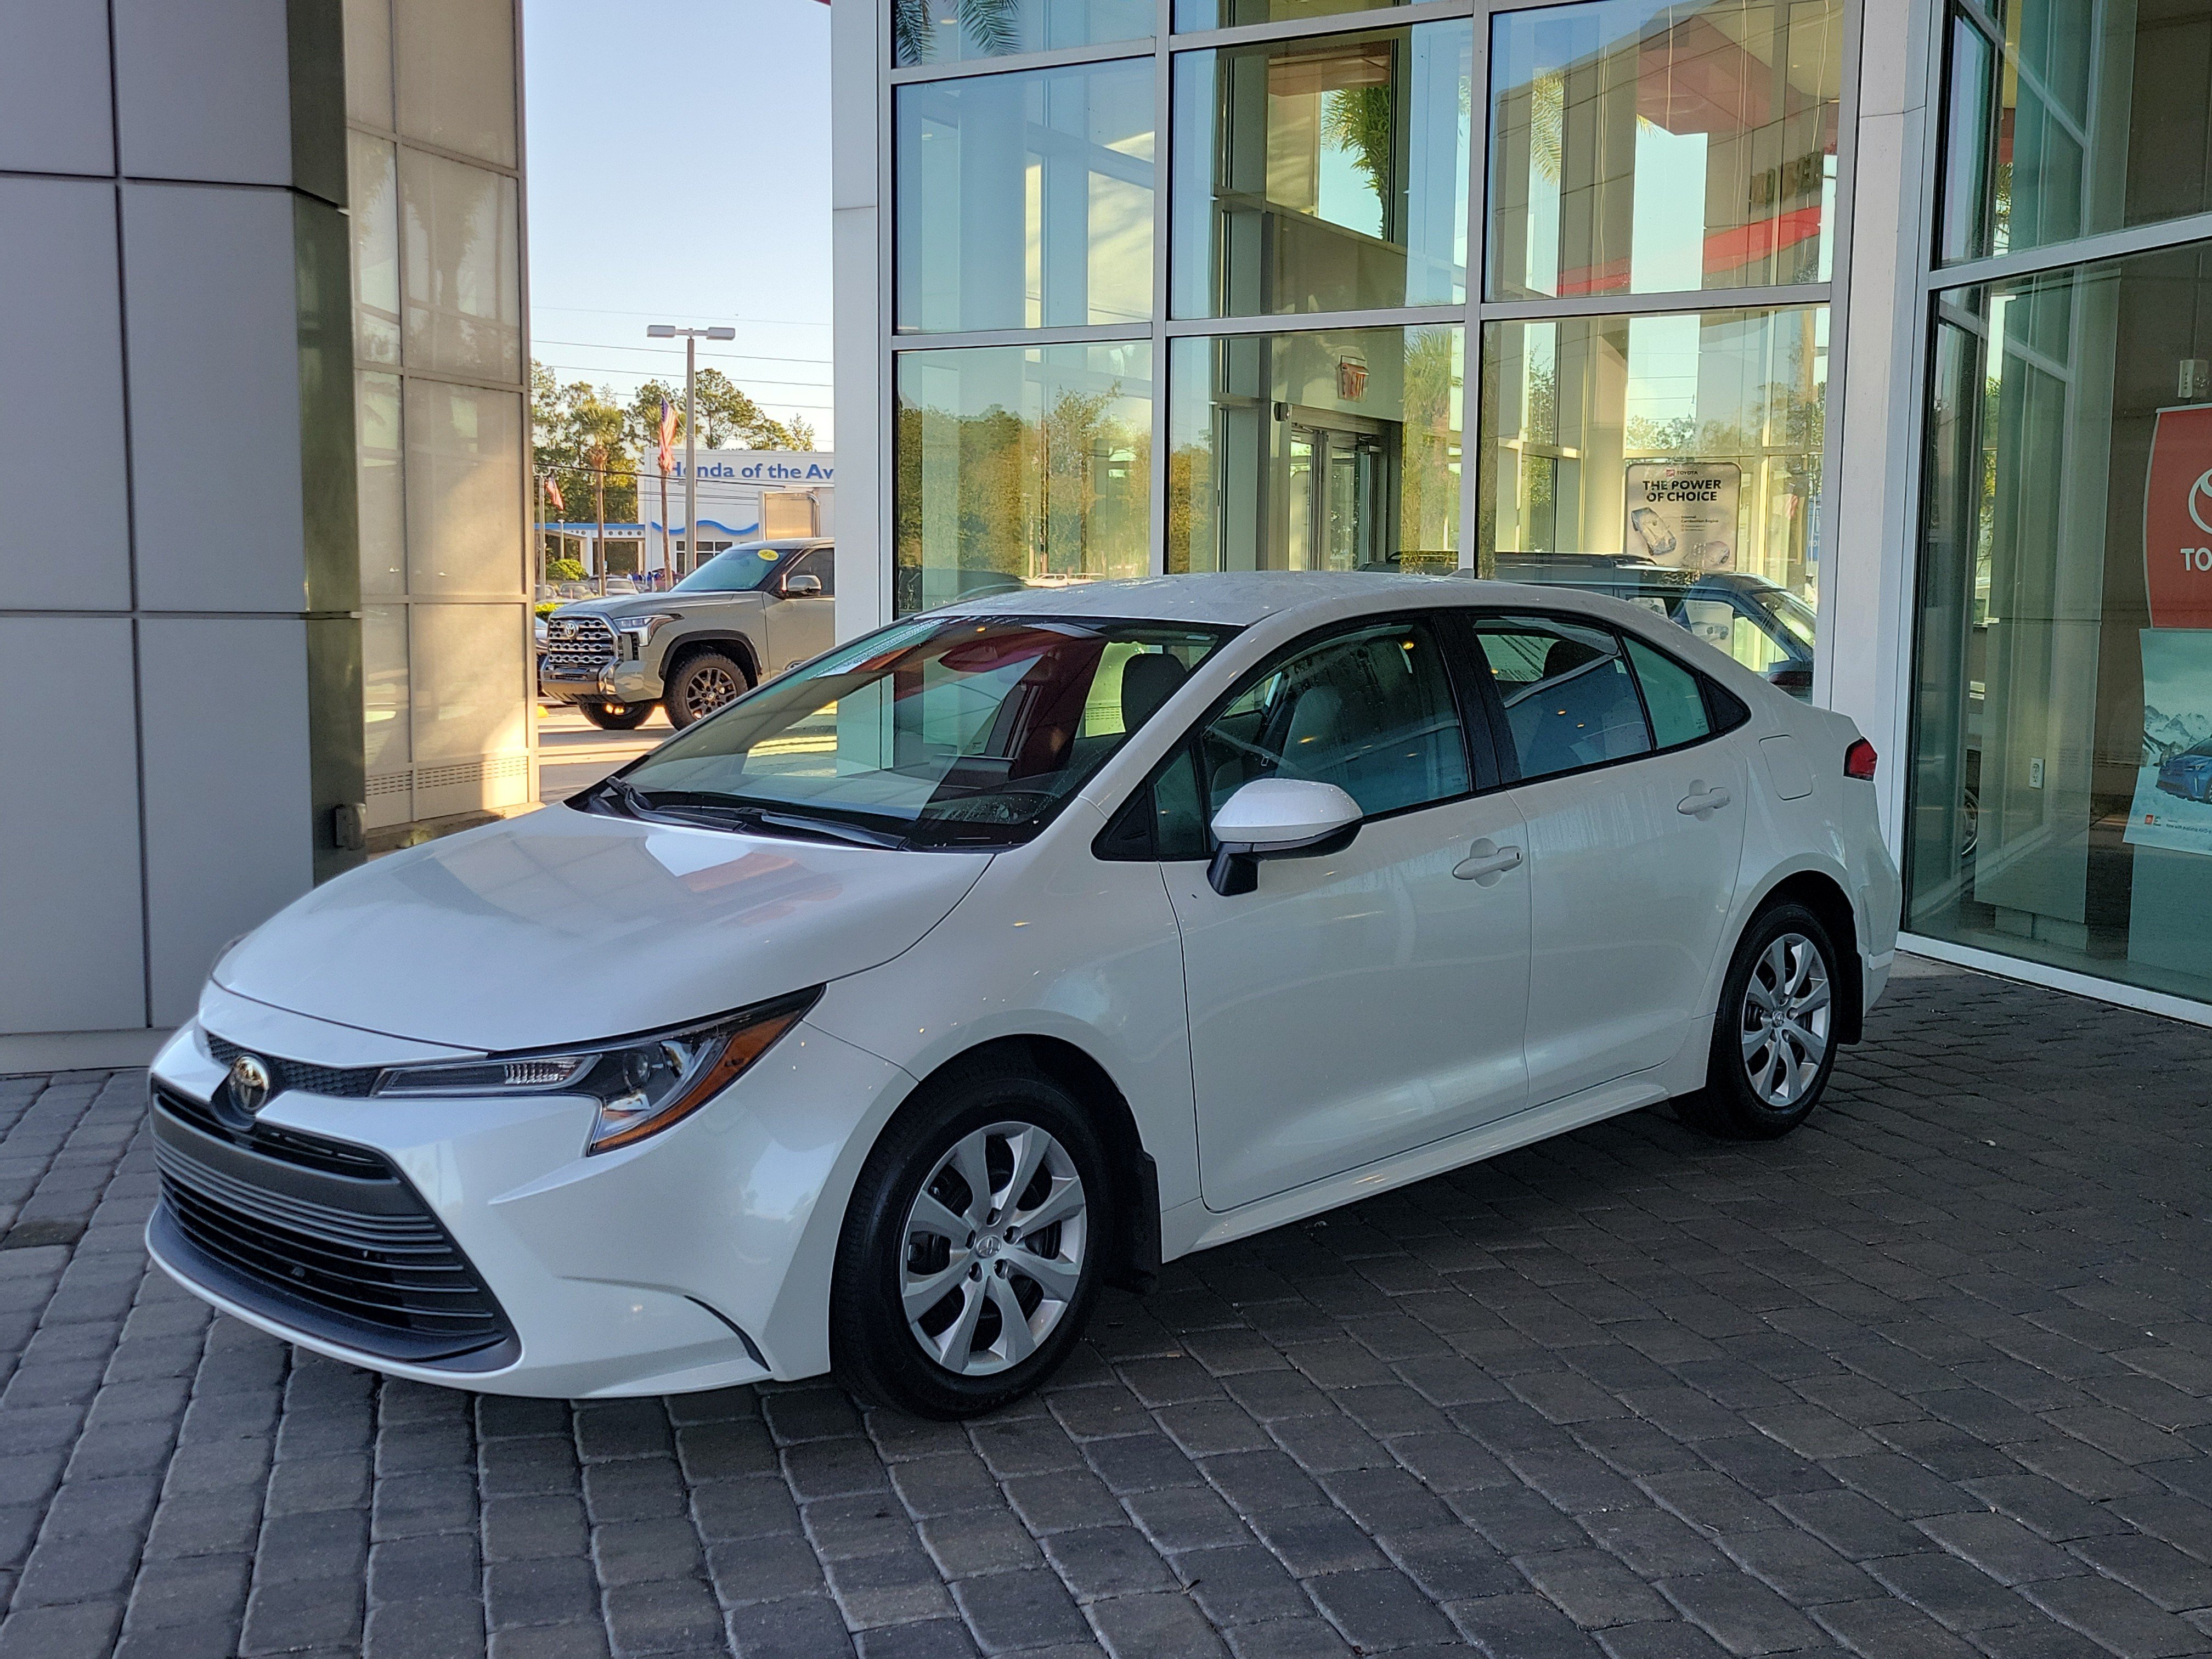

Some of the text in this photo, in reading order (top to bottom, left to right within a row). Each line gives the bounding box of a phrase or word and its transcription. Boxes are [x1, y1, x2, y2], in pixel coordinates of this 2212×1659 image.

[672, 462, 834, 479] Hnda of the Av
[1643, 479, 1722, 490] THE POWER
[1646, 492, 1717, 502] OF CHOICE
[2180, 547, 2212, 571] TO
